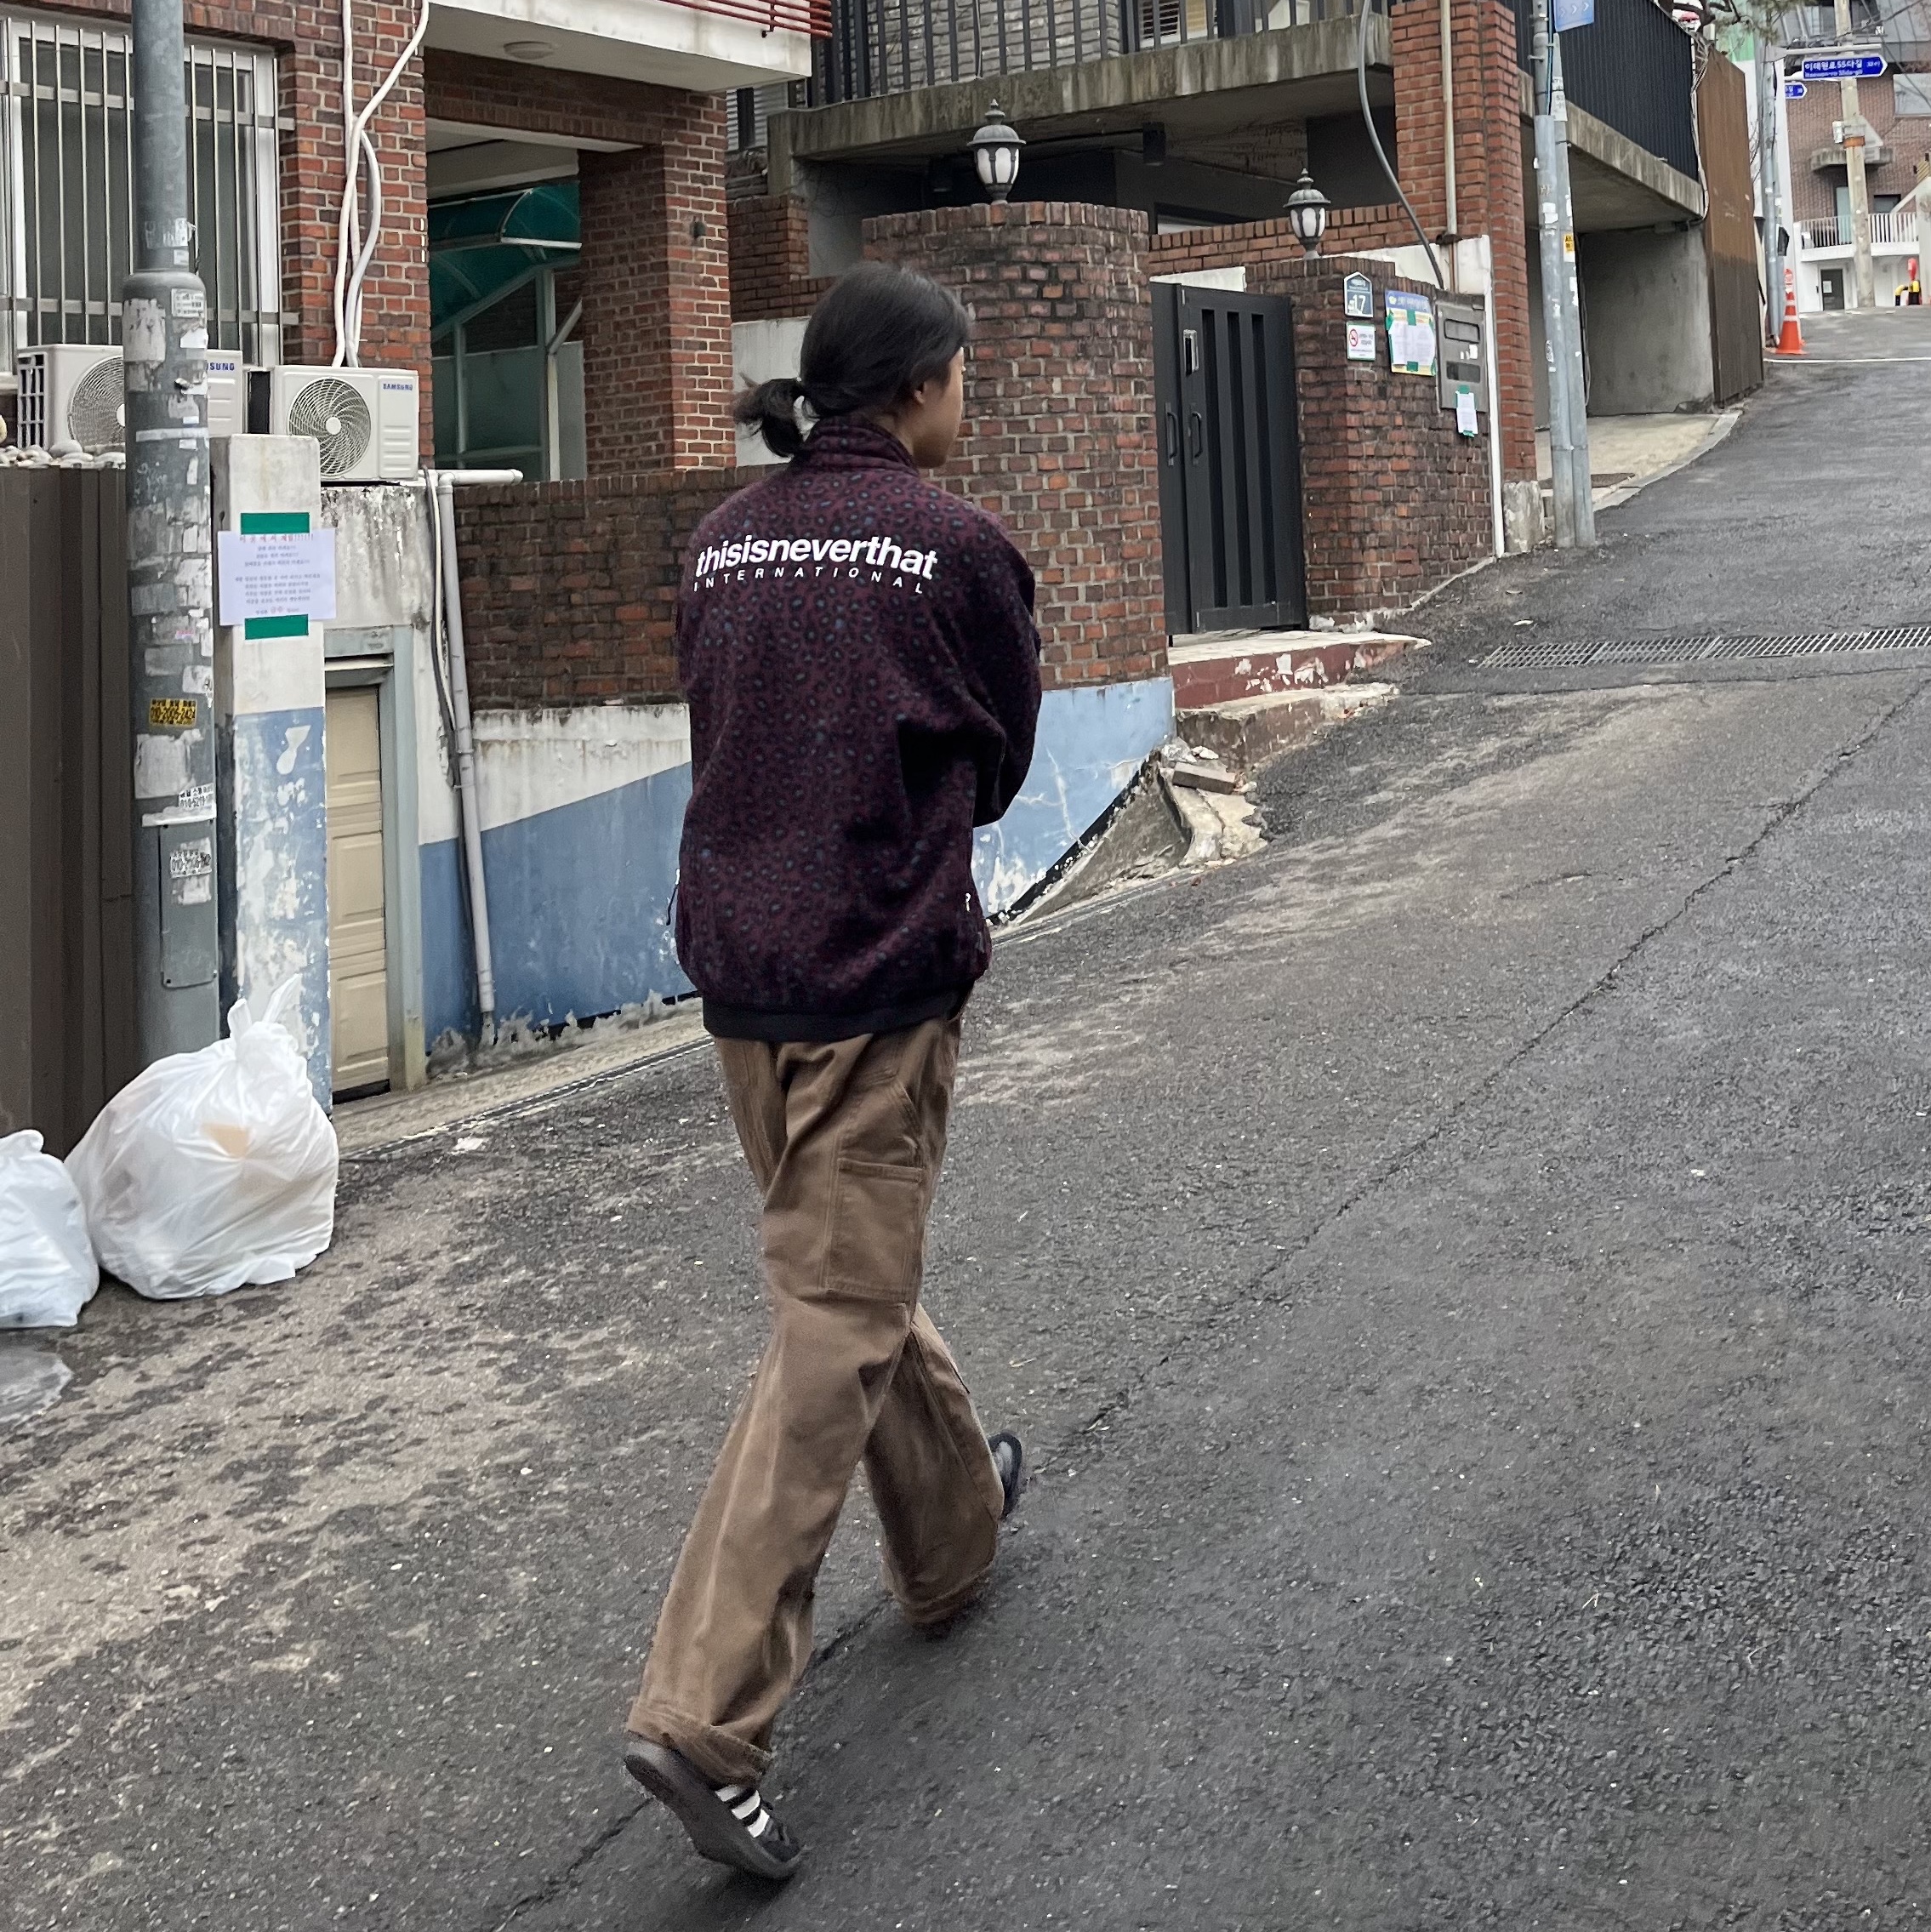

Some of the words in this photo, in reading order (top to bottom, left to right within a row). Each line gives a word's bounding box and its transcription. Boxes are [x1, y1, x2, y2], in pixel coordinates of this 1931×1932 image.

[1353, 294, 1366, 312] 17
[207, 362, 235, 372] SUNG
[382, 383, 413, 391] SAMSUNG
[695, 533, 938, 580] thisisneverthat
[693, 567, 923, 595] INTERNATIONAL
